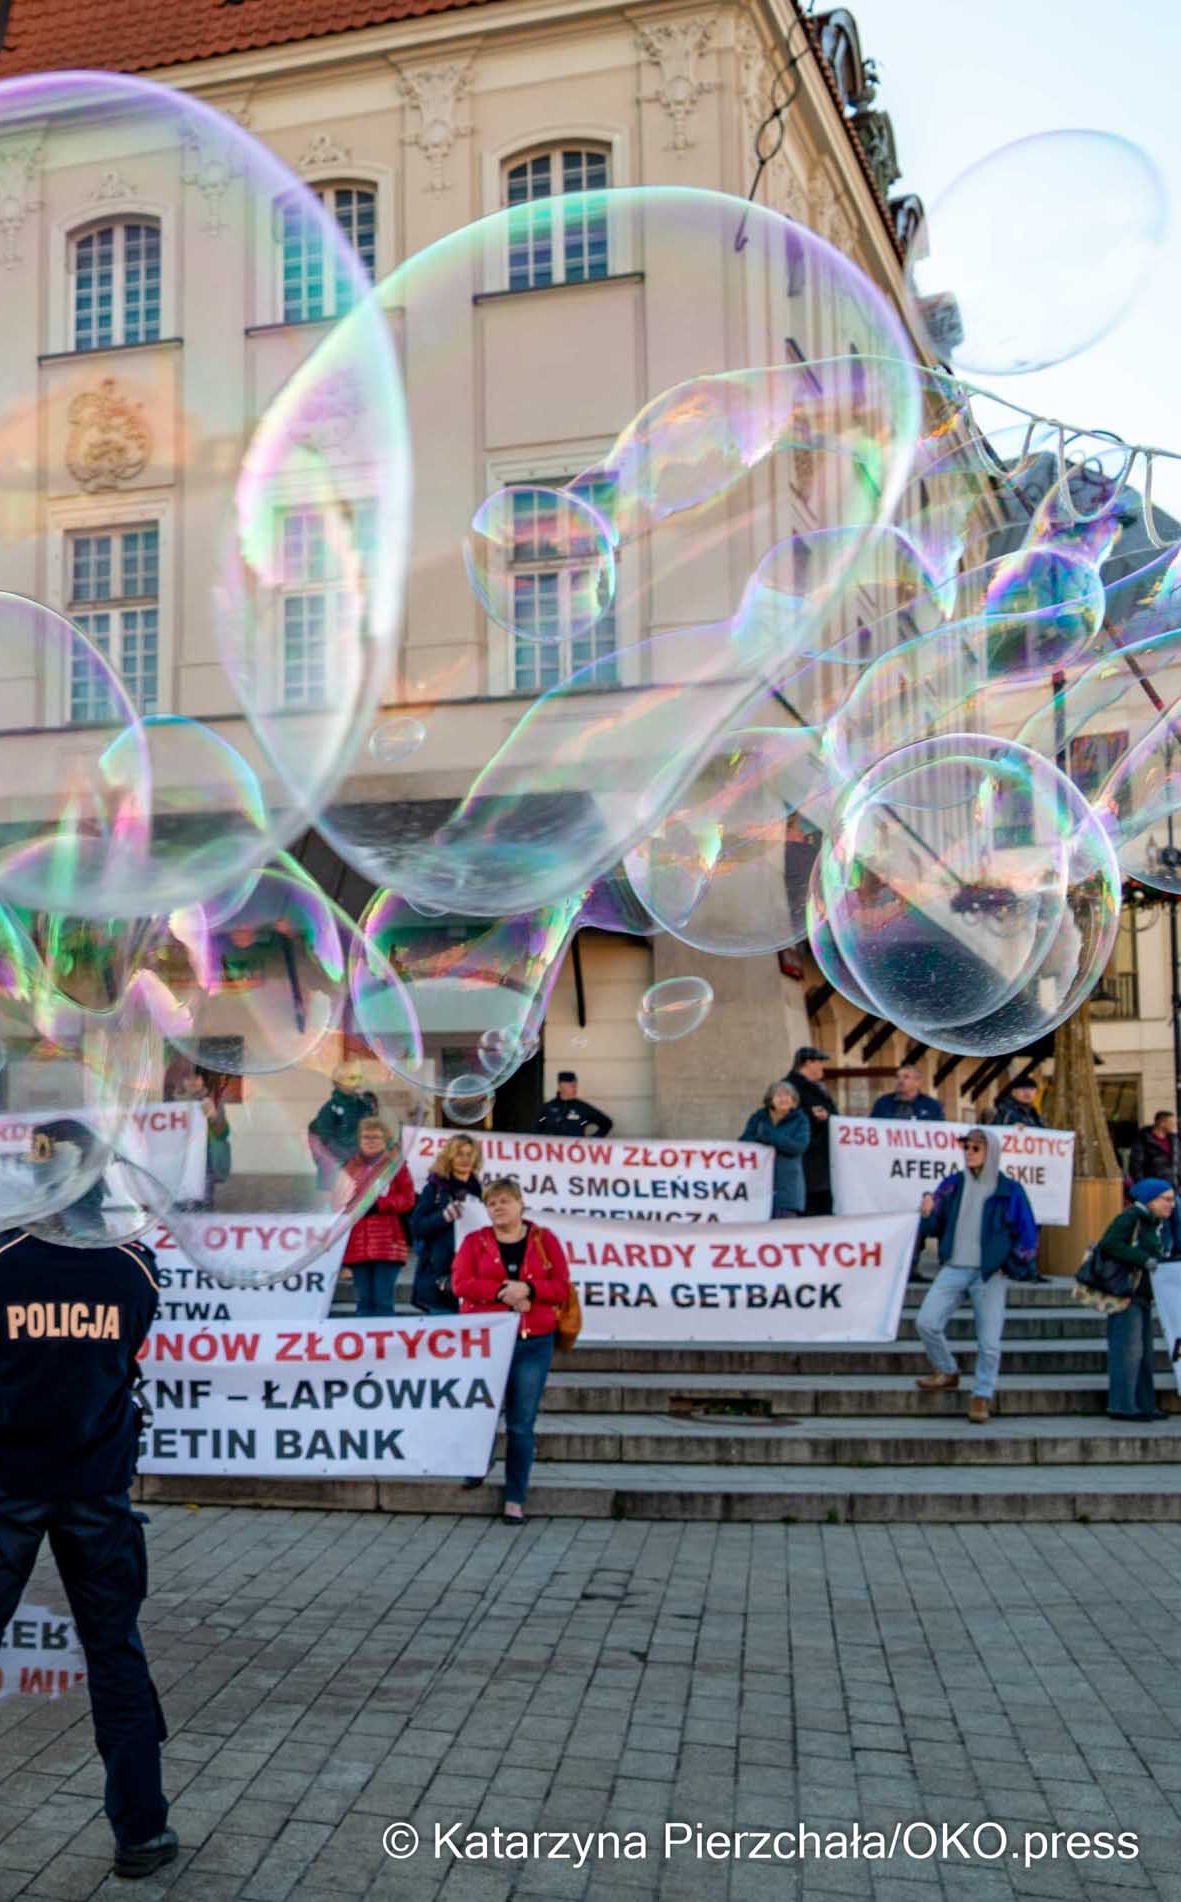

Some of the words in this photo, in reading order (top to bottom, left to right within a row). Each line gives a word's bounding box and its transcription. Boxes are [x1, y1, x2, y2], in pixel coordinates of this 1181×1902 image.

[477, 1136, 612, 1165] ILIONÓW
[622, 1146, 759, 1169] ZŁOTYCH
[839, 1125, 879, 1145] 258
[1003, 1134, 1074, 1156] ZŁOTYC
[568, 1174, 749, 1201] SMOLEŃSKA
[155, 1225, 332, 1251] ZOTYCH
[711, 1240, 883, 1268] ZŁOTYCH
[671, 1282, 843, 1309] GETBACK
[6, 1302, 120, 1340] POLICJA
[275, 1327, 493, 1361] ZŁOTYCH
[262, 1371, 496, 1411] ŁAPÓWKA
[275, 1429, 406, 1461] BANK
